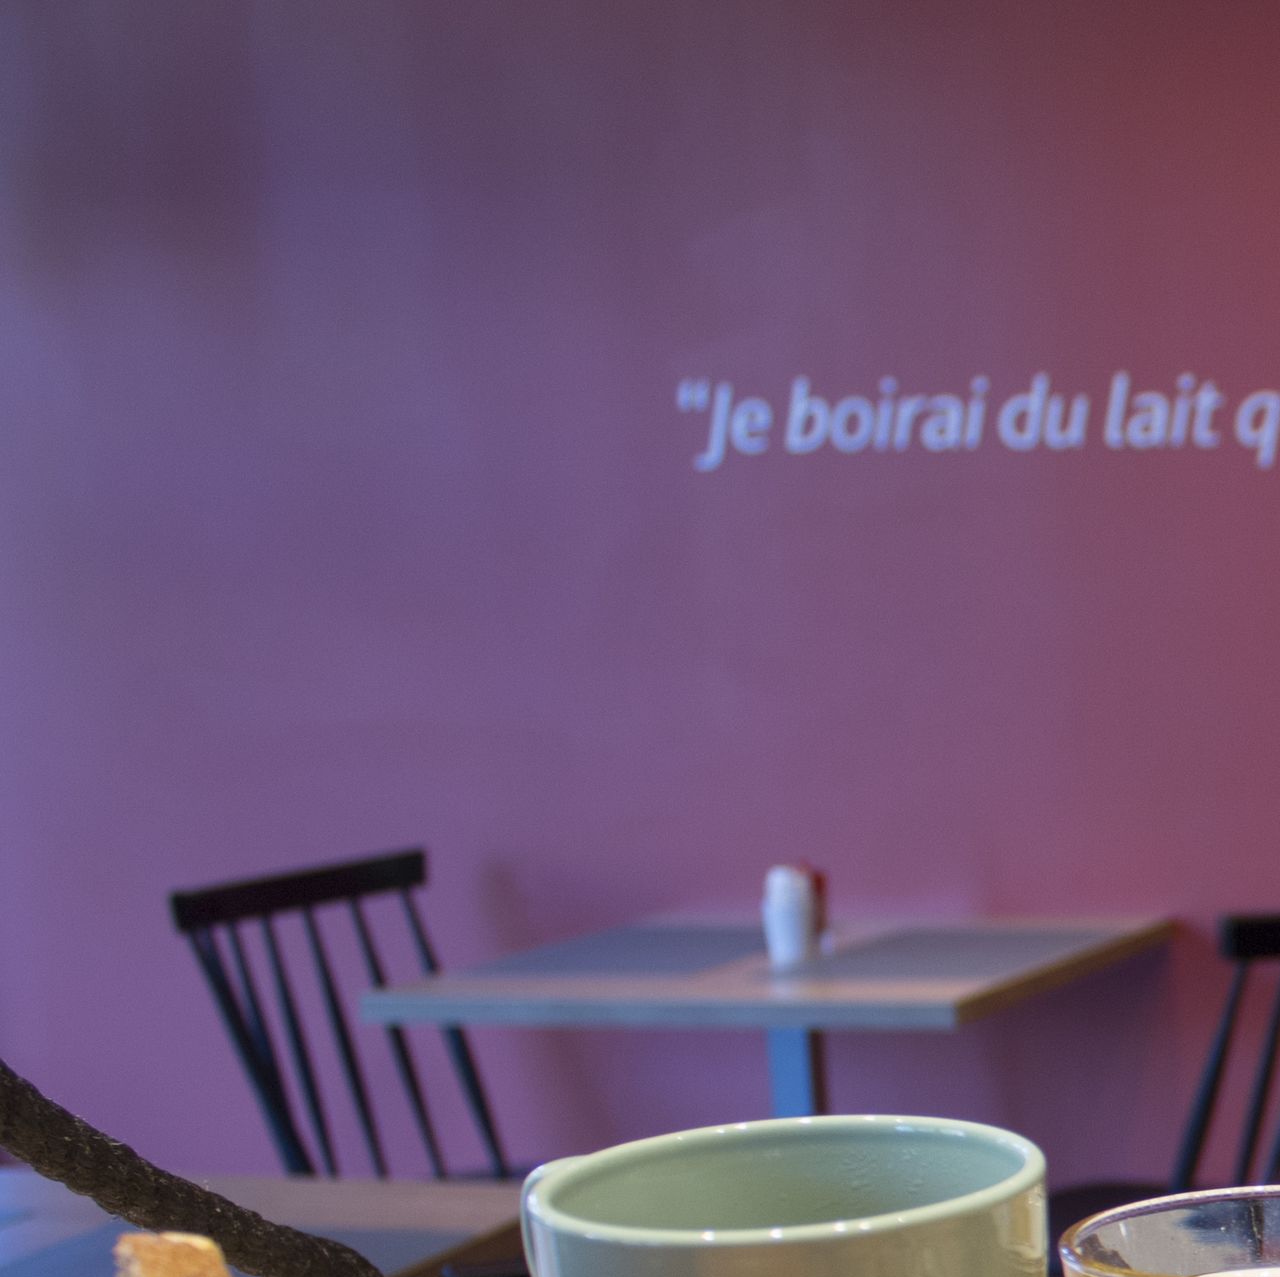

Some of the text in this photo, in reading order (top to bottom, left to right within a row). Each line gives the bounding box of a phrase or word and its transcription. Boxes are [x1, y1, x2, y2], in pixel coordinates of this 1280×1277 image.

[786, 378, 986, 452] boirai
[999, 375, 1088, 449] du
[1105, 374, 1221, 448] lait
